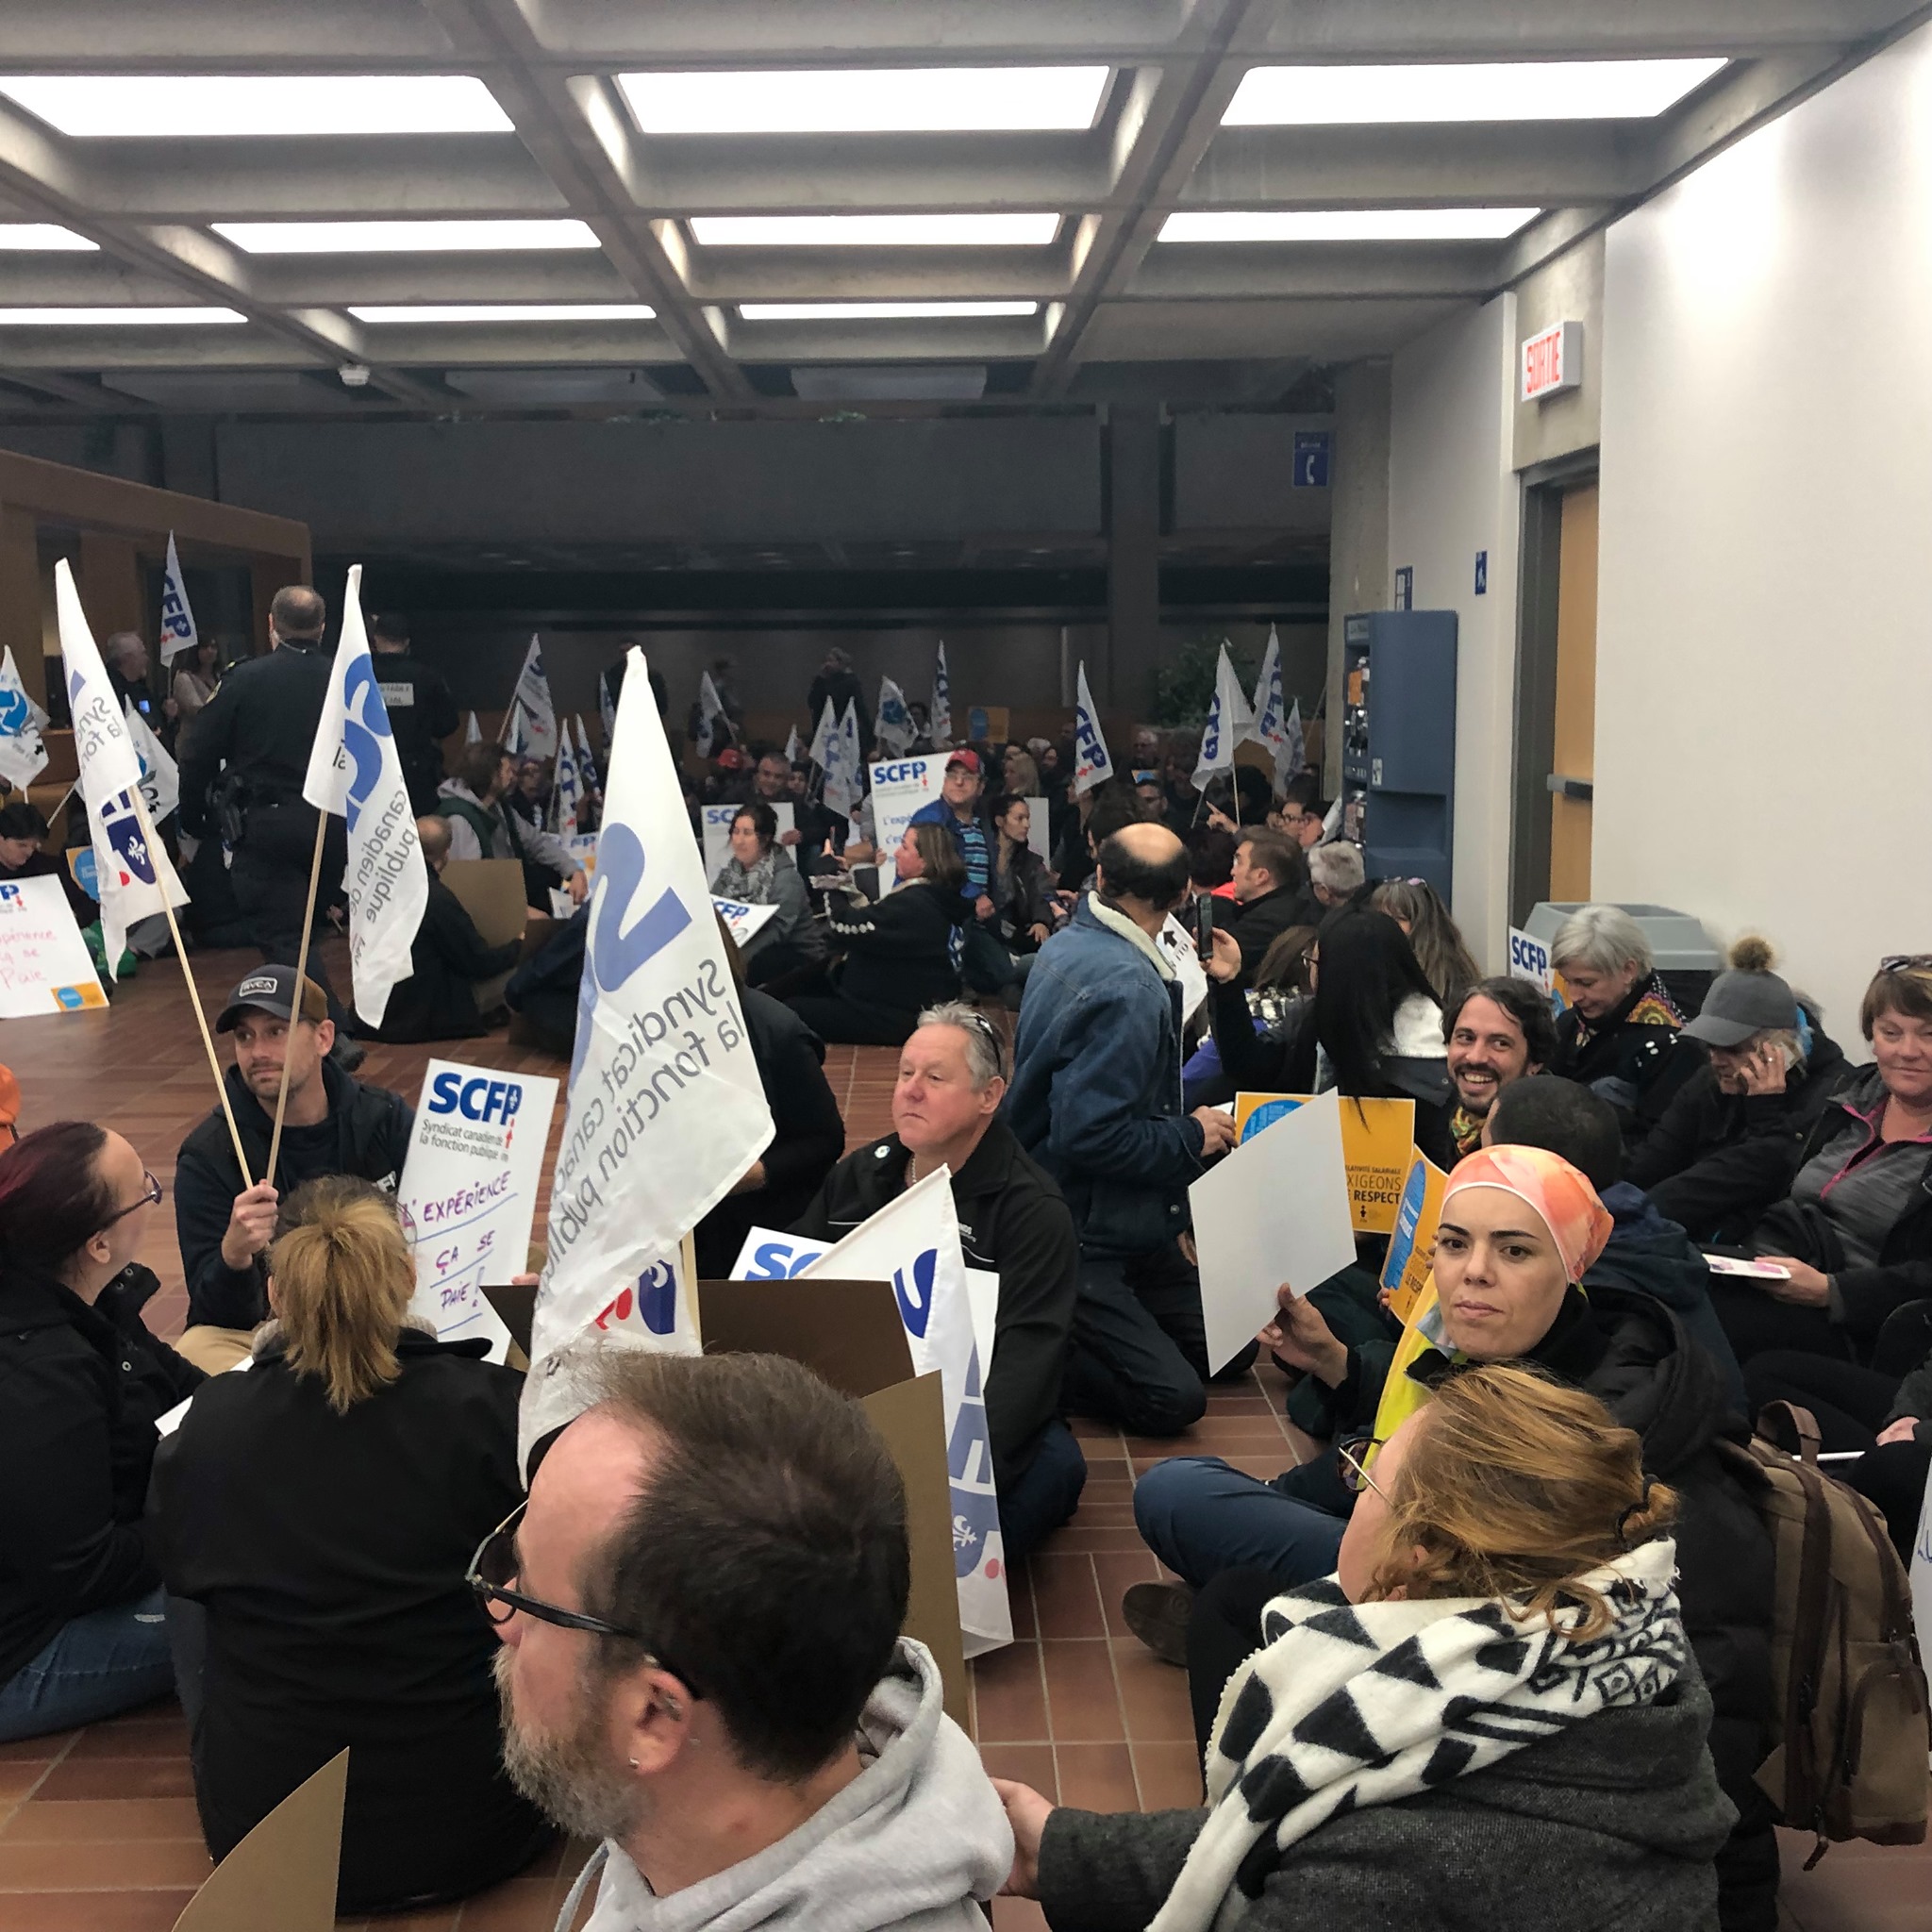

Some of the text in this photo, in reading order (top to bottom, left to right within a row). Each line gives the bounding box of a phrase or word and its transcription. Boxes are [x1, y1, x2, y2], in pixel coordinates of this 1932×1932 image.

[1526, 331, 1560, 393] SORTIE
[874, 760, 926, 785] SCFP
[1511, 935, 1547, 976] SCFP
[428, 1072, 523, 1125] SCFP
[422, 1118, 462, 1138] Syndicat
[420, 1133, 428, 1144] la
[431, 1134, 470, 1153] fonction
[1347, 1174, 1402, 1191] XIGEONS
[1354, 1190, 1400, 1205] RESPECT
[476, 1230, 495, 1252] SE
